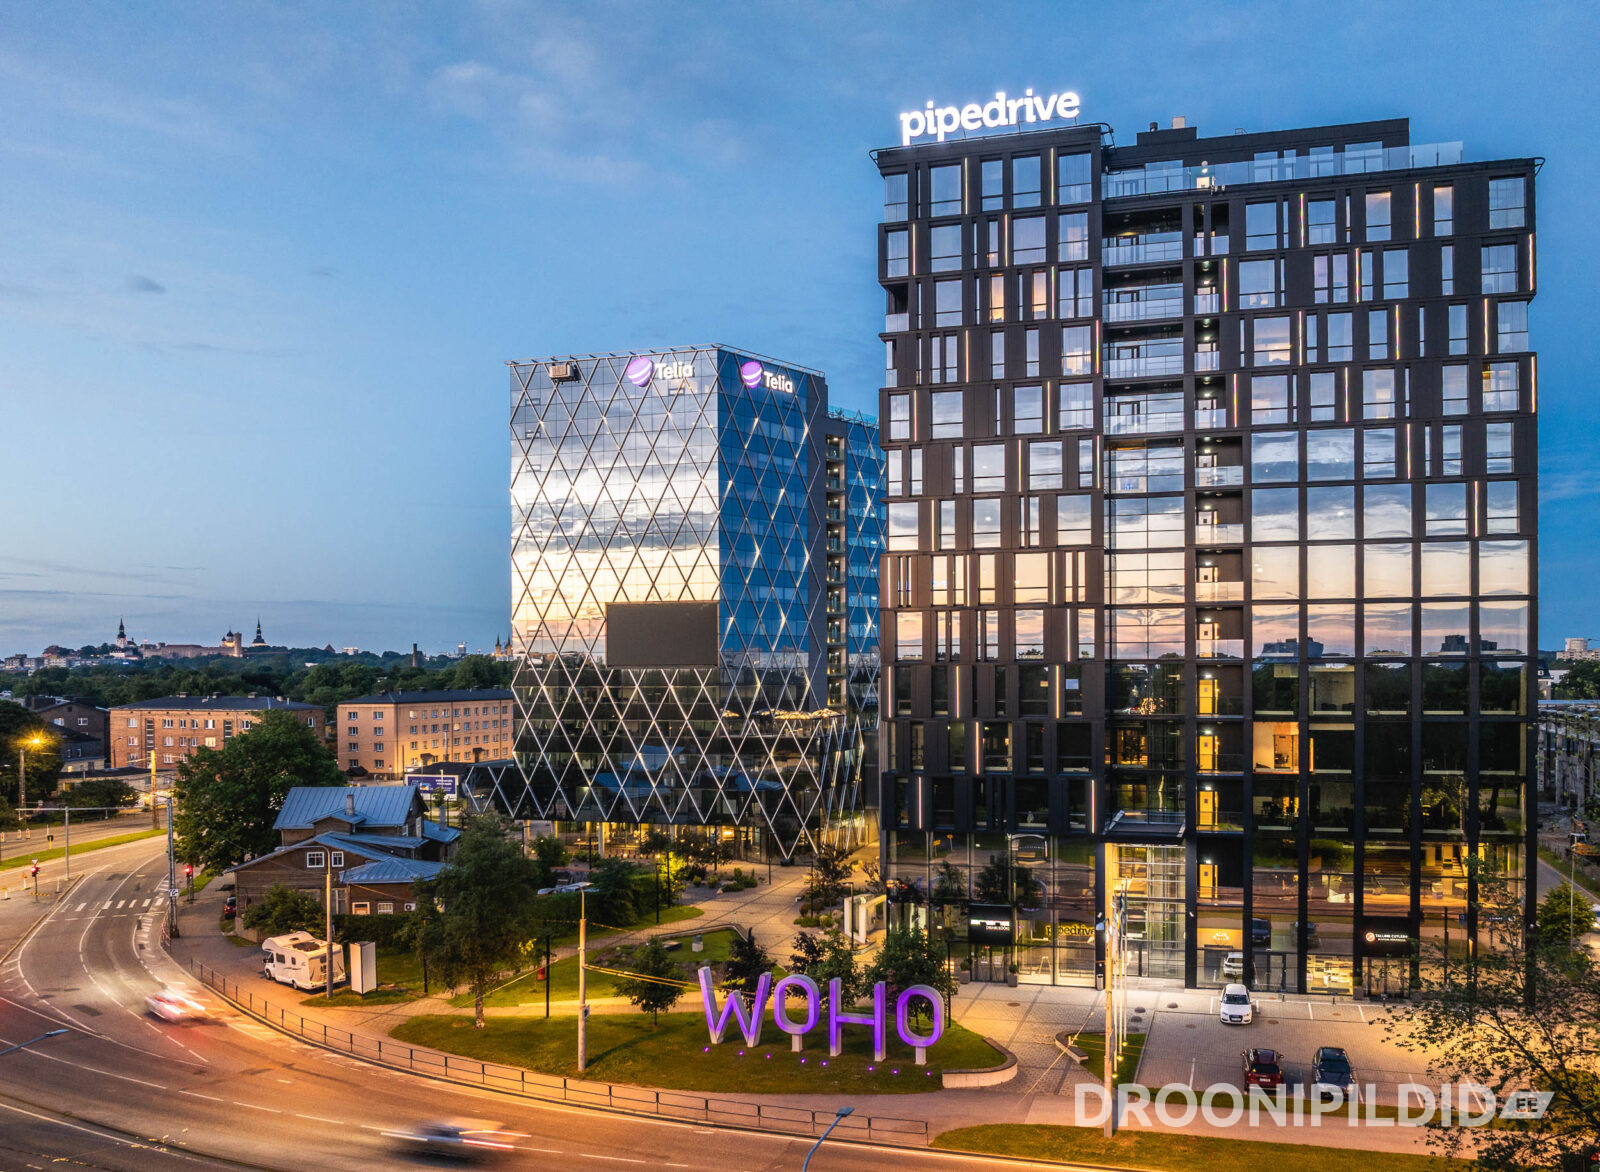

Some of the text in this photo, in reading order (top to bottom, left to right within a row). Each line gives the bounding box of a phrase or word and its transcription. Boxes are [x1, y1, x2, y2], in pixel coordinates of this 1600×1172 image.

[899, 88, 1081, 146] pipedrive
[655, 360, 695, 379] Telia
[763, 370, 794, 393] Telia
[698, 966, 945, 1064] WOHO
